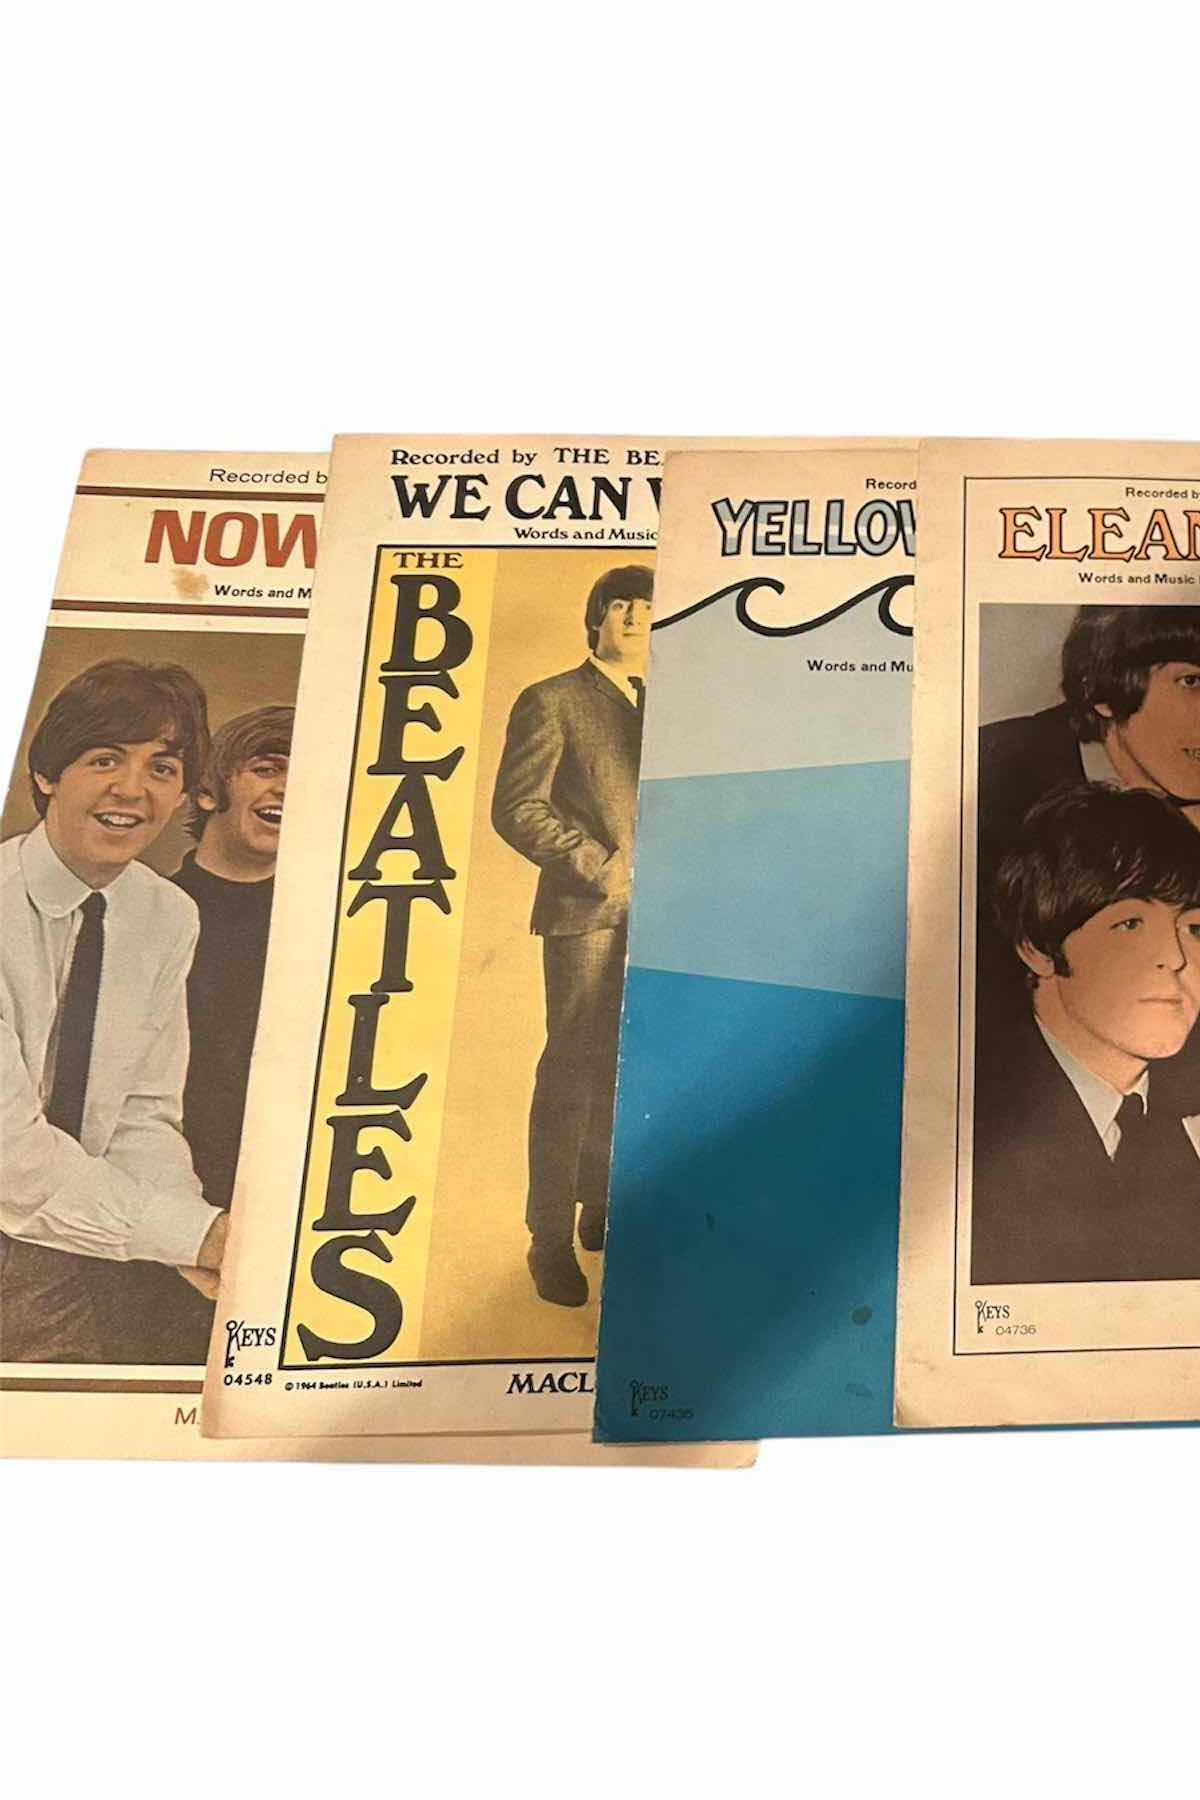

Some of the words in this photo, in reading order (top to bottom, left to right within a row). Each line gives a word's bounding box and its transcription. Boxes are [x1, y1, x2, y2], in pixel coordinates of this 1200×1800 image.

[391, 449, 499, 465] Recorded
[512, 449, 538, 466] by
[554, 447, 610, 464] THE
[626, 450, 665, 467] BE
[208, 468, 310, 484] Recorded
[865, 478, 917, 490] Record
[391, 473, 491, 521] WE
[505, 474, 632, 521] CAN
[1125, 487, 1188, 499] Recorded
[514, 527, 568, 540] Words
[573, 528, 605, 540] and
[393, 552, 464, 569] THE
[1078, 571, 1123, 584] Words
[1128, 573, 1151, 584] and
[1154, 573, 1195, 584] Music
[214, 585, 263, 598] Words
[267, 587, 293, 598] and
[807, 659, 856, 672] Words
[861, 661, 886, 672] and
[297, 574, 473, 1361] BEATLES
[223, 1373, 273, 1387] 04548
[174, 1407, 200, 1425] M
